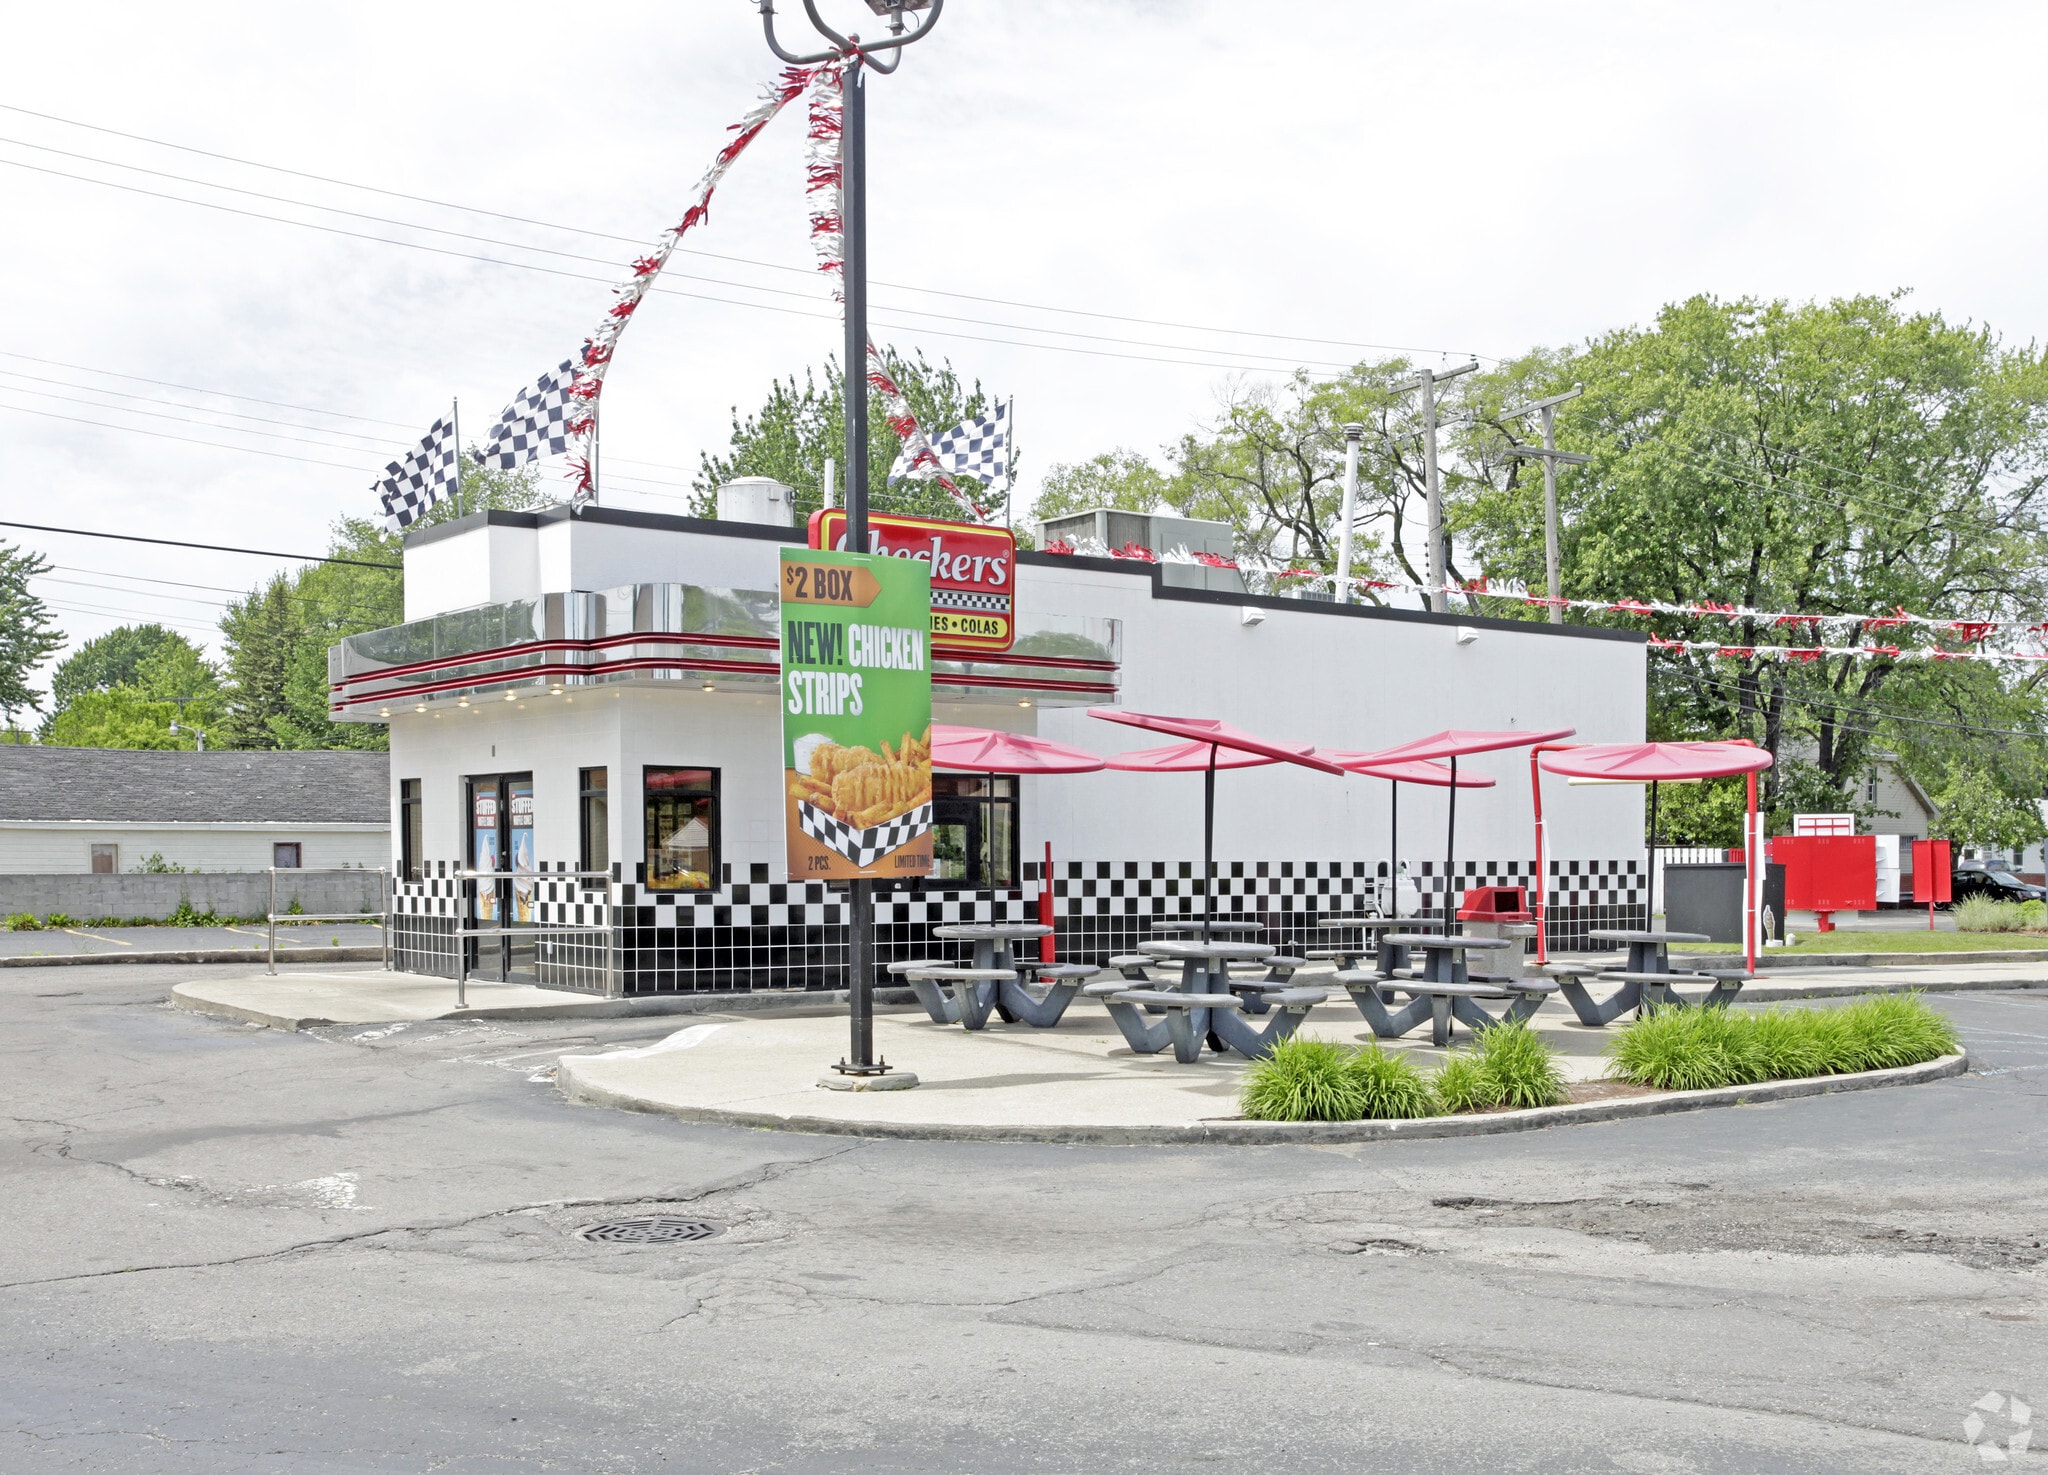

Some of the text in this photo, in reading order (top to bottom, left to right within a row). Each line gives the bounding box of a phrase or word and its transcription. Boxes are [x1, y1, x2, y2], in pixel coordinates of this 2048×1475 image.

[836, 529, 1008, 586] hkers
[786, 566, 853, 601] $2 BOX
[787, 620, 924, 671] NEW! CHICKEN
[961, 618, 998, 635] COLAS
[788, 670, 863, 716] STRIPS
[808, 856, 831, 870] 2 PCS.
